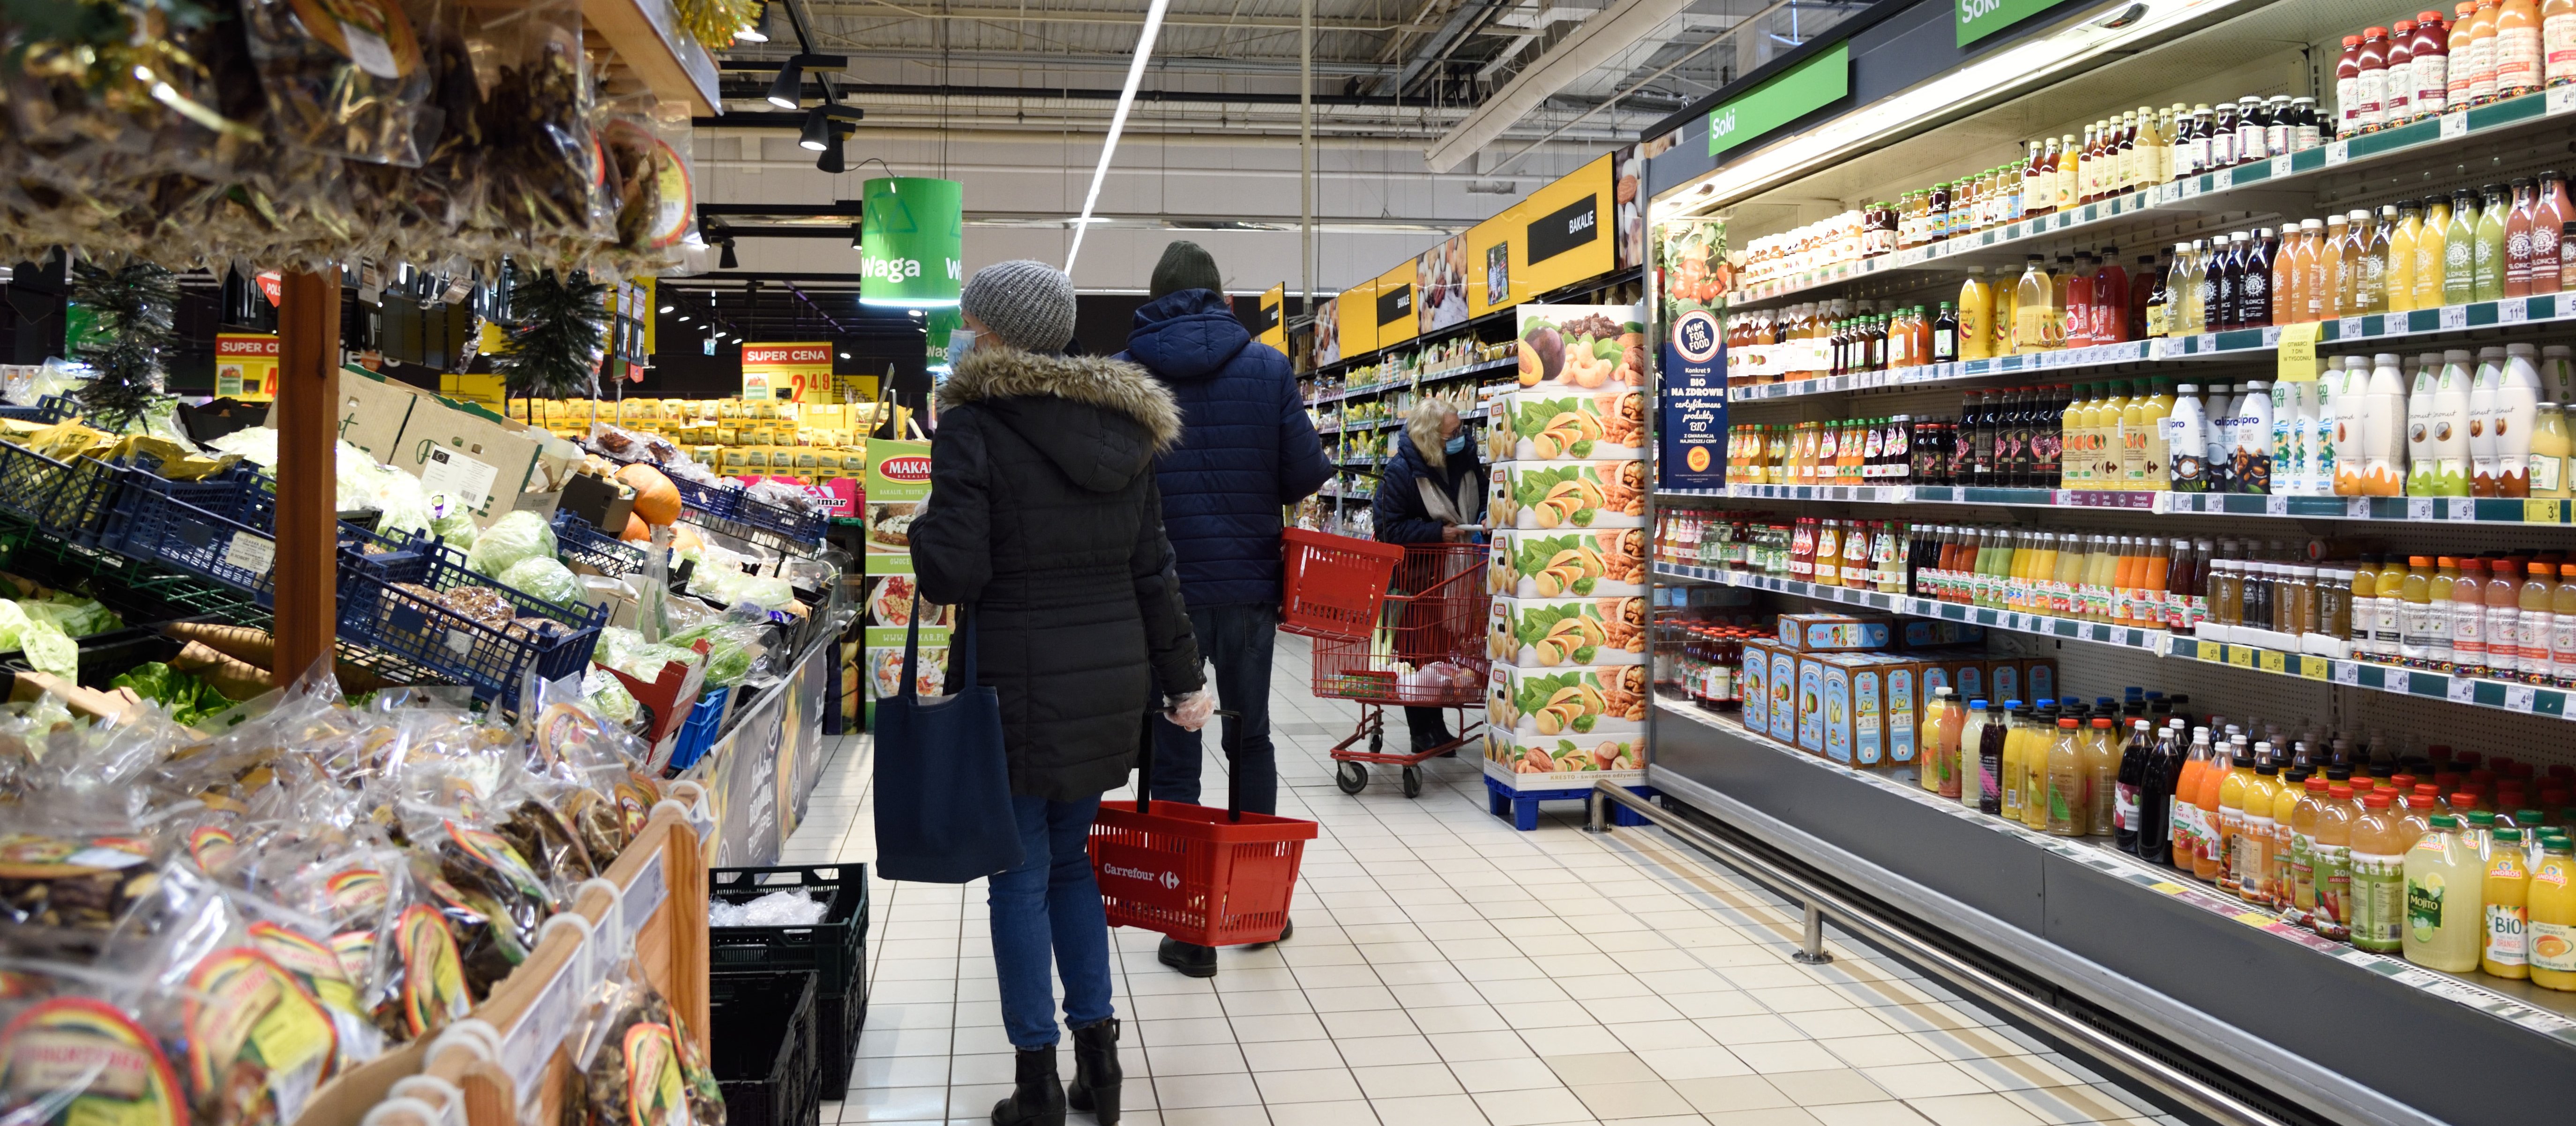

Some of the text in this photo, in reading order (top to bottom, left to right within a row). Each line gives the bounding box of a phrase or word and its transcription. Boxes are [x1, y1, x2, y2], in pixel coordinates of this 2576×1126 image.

[1712, 108, 1735, 140] Soki
[1569, 210, 1594, 234] BAKALIE
[861, 255, 921, 283] Waga
[1397, 294, 1410, 309] BAKALIE
[1689, 330, 1705, 342] FOR
[221, 342, 262, 352] SUPER
[1689, 338, 1710, 351] FOOD
[747, 350, 826, 361] SUPER CENA
[926, 345, 949, 361] Wag
[1690, 378, 1706, 387] BIO
[1671, 388, 1723, 397] NA ZDROWIE
[1674, 399, 1722, 412] certyfikowane
[1682, 410, 1715, 424] produkty
[1690, 422, 1707, 432] BIO
[2124, 433, 2148, 449] BIO
[889, 461, 932, 474] MAKA
[1495, 606, 1505, 615] KRESTO
[883, 634, 945, 642] WWW.KAR.PL
[1495, 672, 1505, 682] KRESTO
[2419, 842, 2444, 851] ANDROS
[2294, 857, 2307, 865] SOK
[1104, 863, 1154, 881] Carrefour
[2536, 874, 2566, 884] ANDROS
[2535, 926, 2566, 937] Pomarańczy
[2496, 938, 2521, 949] ORANGES
[2535, 958, 2569, 969] Wyciskanych
